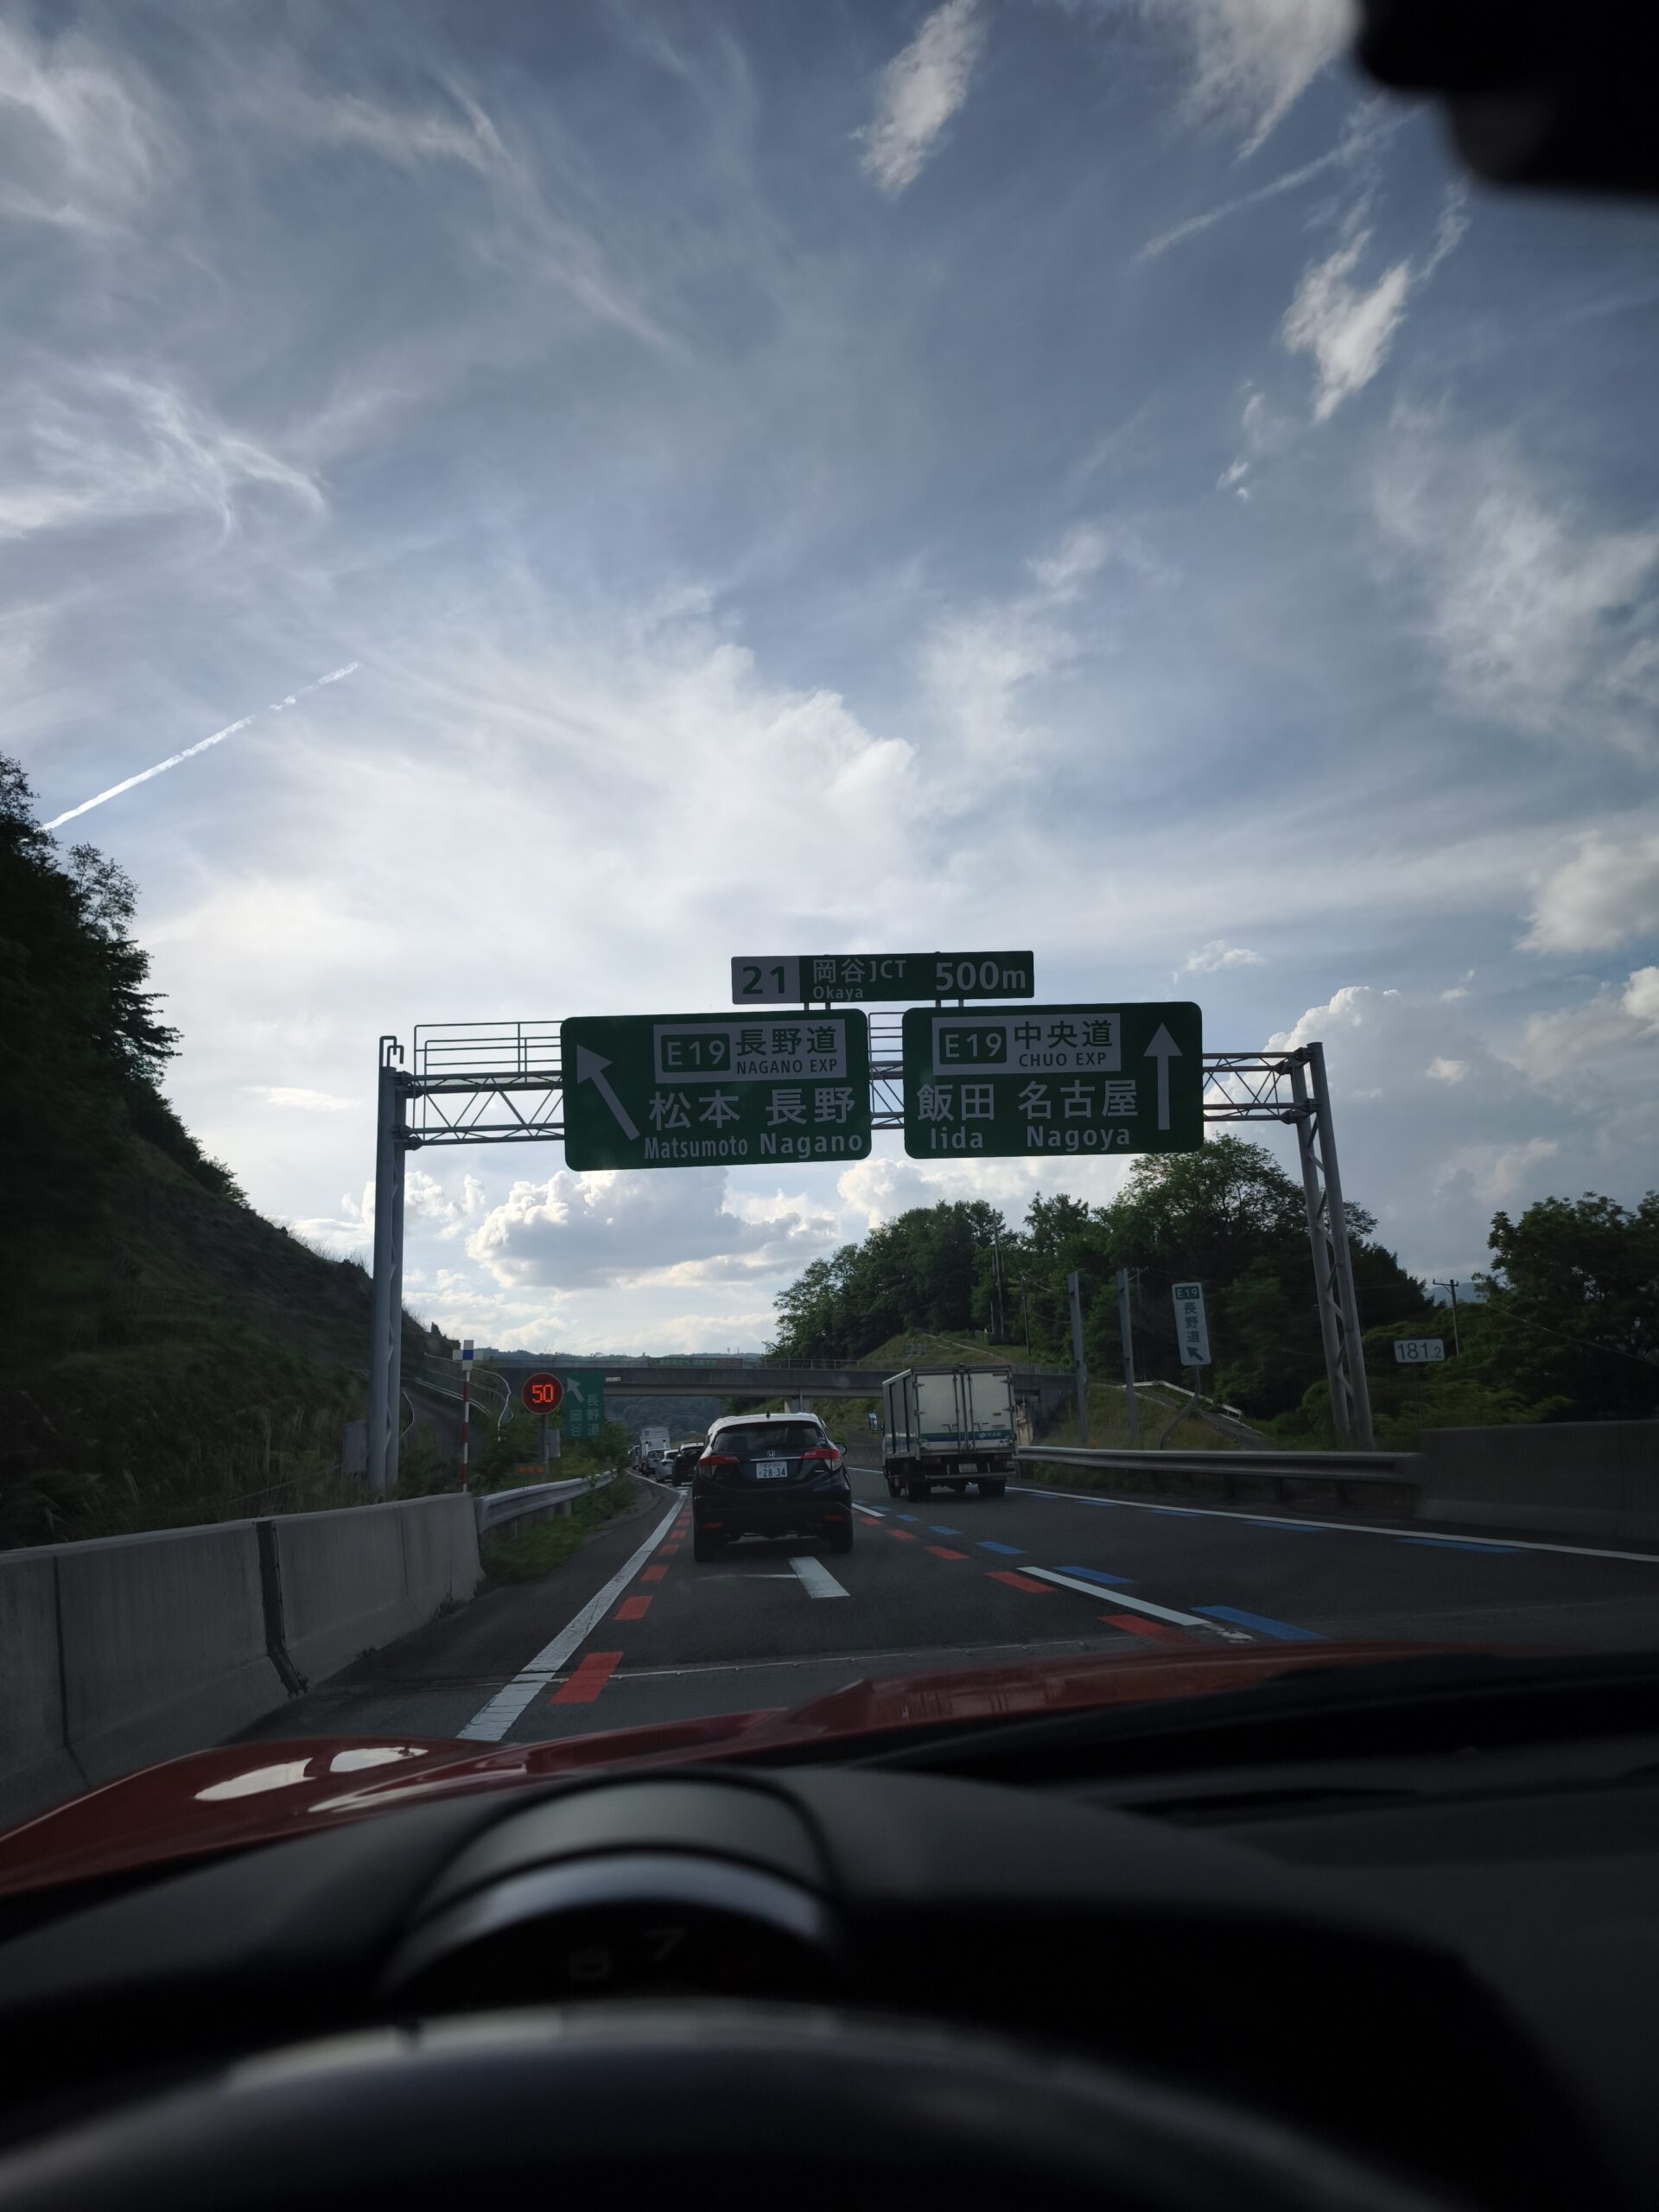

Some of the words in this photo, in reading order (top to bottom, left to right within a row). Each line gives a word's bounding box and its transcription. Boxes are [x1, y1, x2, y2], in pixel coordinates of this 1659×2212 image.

[741, 965, 786, 995] 21
[812, 958, 907, 984] 岡谷JCT
[935, 960, 1026, 991] 500m
[812, 986, 864, 1001] Okaya
[735, 1026, 838, 1057] 長野道
[944, 1033, 1002, 1058] E19
[1014, 1020, 1113, 1050] 中央道
[666, 1039, 726, 1066] E19
[736, 1058, 803, 1075] NAGANO
[810, 1058, 837, 1072] EXP
[1019, 1052, 1067, 1068] CHUO
[1076, 1052, 1107, 1066] EXP
[648, 1090, 741, 1131] 松本
[765, 1086, 855, 1127] 長野
[916, 1083, 995, 1122] 飯田
[1018, 1078, 1139, 1120] 名古屋
[645, 1135, 748, 1160] Matsumoto
[760, 1132, 863, 1160] Nagano
[930, 1126, 984, 1150] Iida
[1026, 1125, 1131, 1153] Nagoya
[1176, 1287, 1198, 1298] E19
[1183, 1302, 1200, 1343] 長野道
[1397, 1342, 1443, 1360] 181.2
[531, 1383, 554, 1404] 50
[587, 1394, 600, 1436] 長野道
